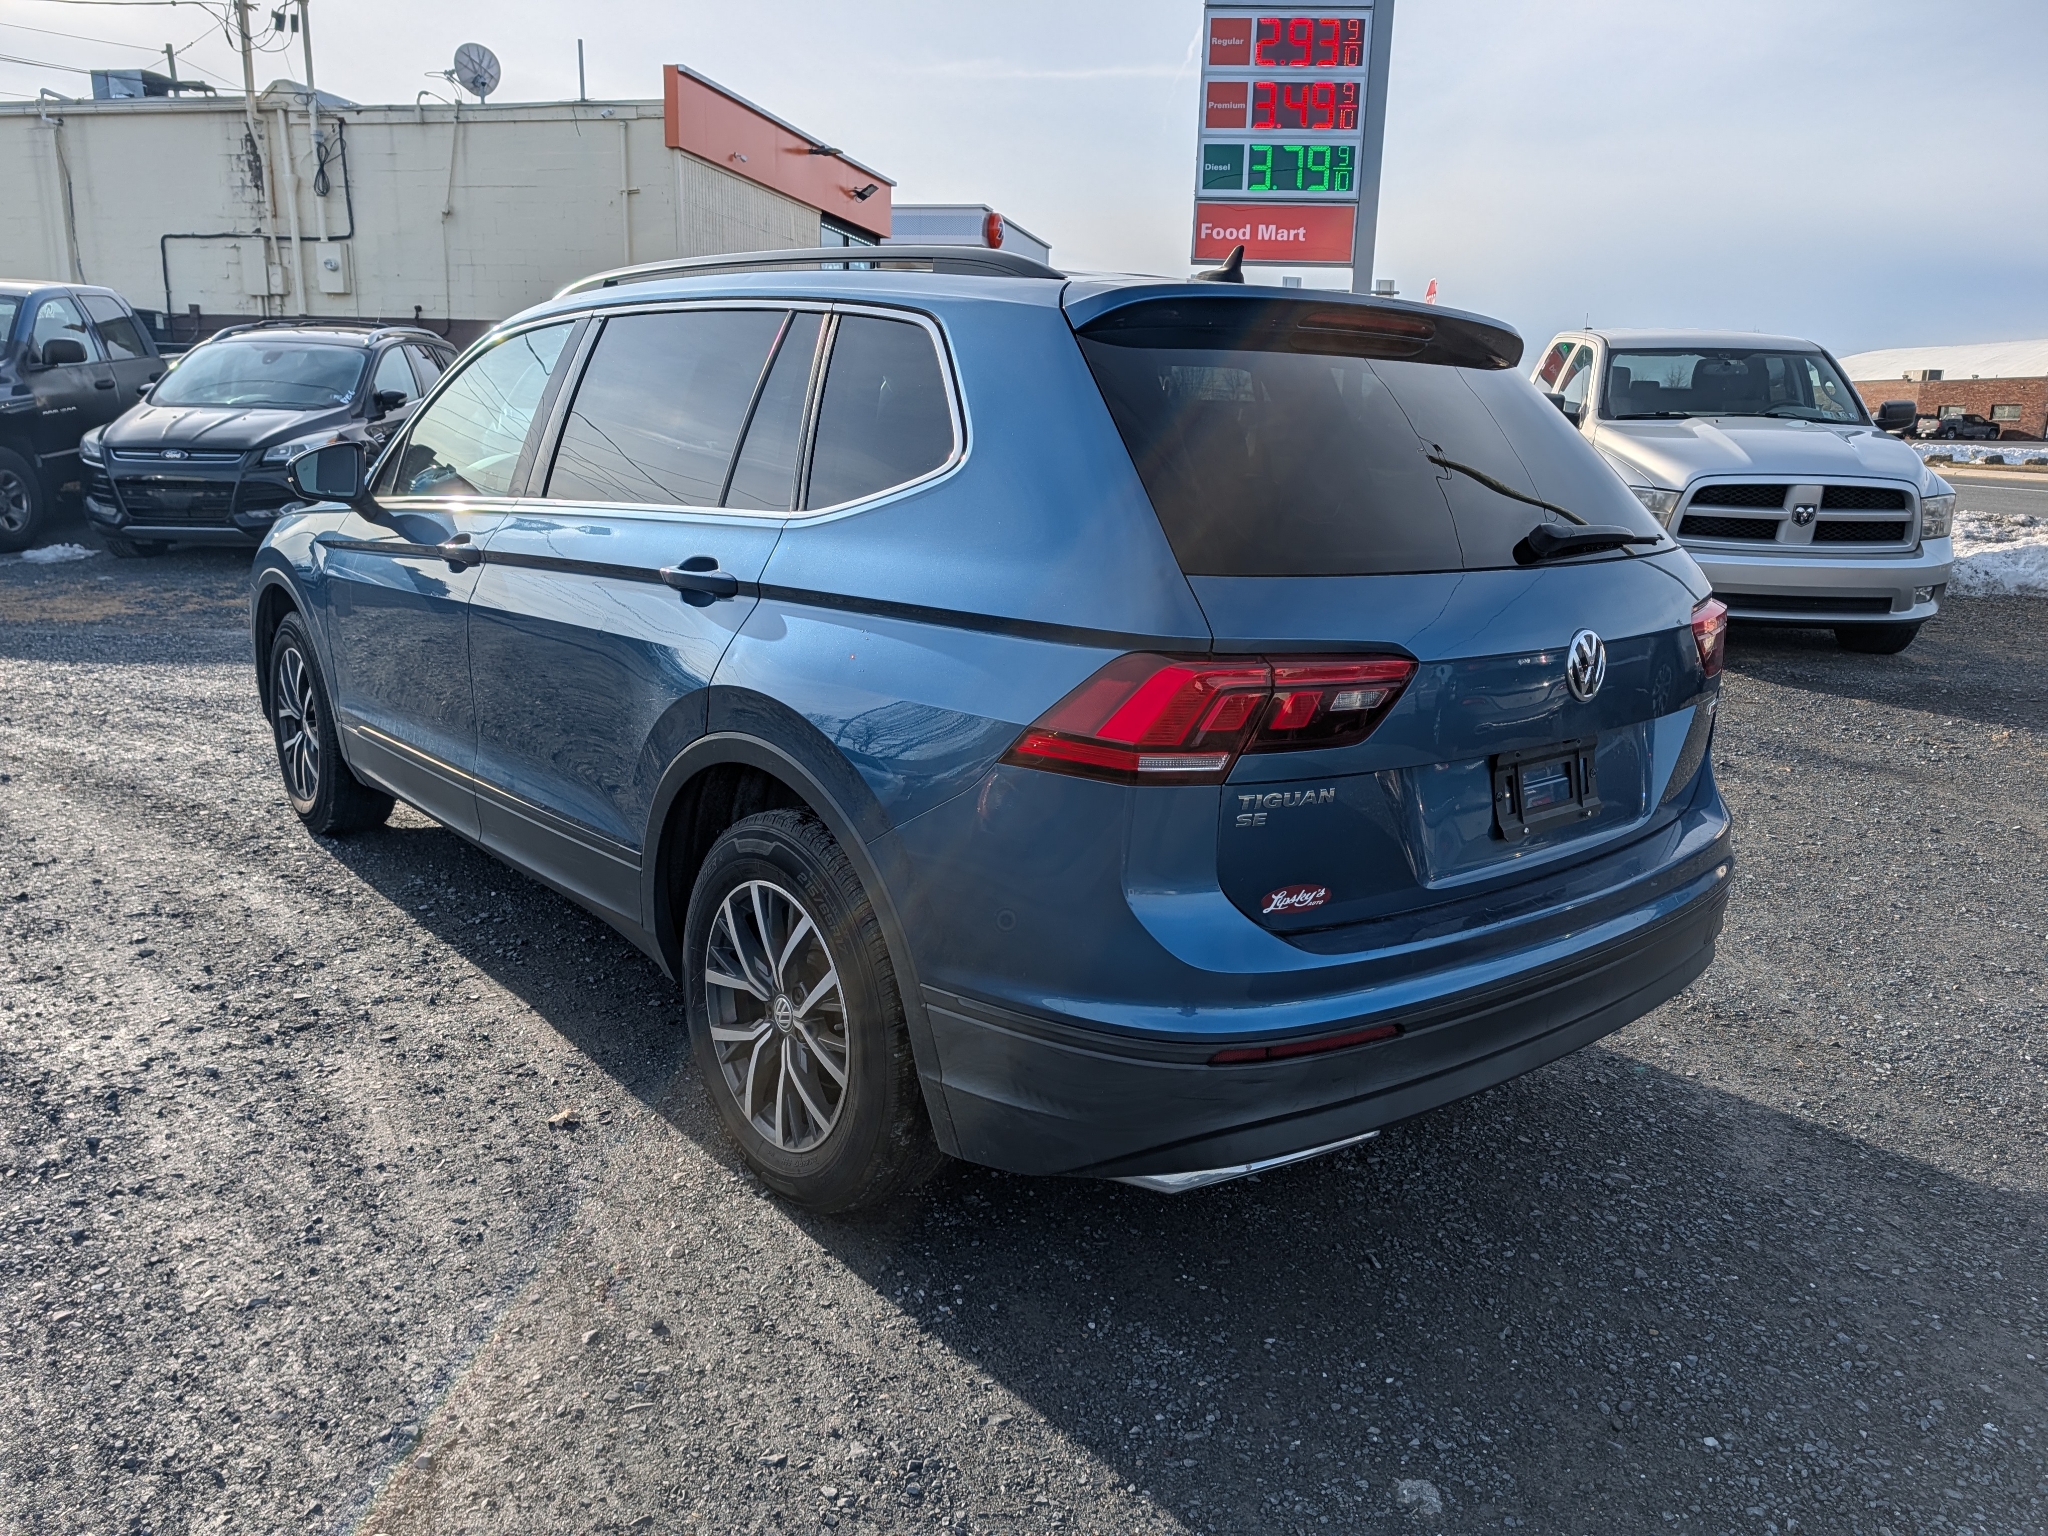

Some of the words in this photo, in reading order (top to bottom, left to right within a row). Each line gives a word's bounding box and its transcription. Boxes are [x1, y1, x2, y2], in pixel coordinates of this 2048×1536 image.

[1211, 37, 1244, 46] Regular
[1255, 17, 1340, 67] 2.93
[1208, 101, 1246, 109] Premium
[1252, 81, 1336, 130] 3.49
[1204, 163, 1231, 171] Diesel
[1249, 145, 1331, 191] 3.79
[1200, 222, 1251, 240] Food
[1257, 224, 1307, 242] Mart
[1238, 787, 1335, 810] TIGUAN
[1235, 812, 1267, 828] SE
[1262, 887, 1326, 914] Lipsky's
